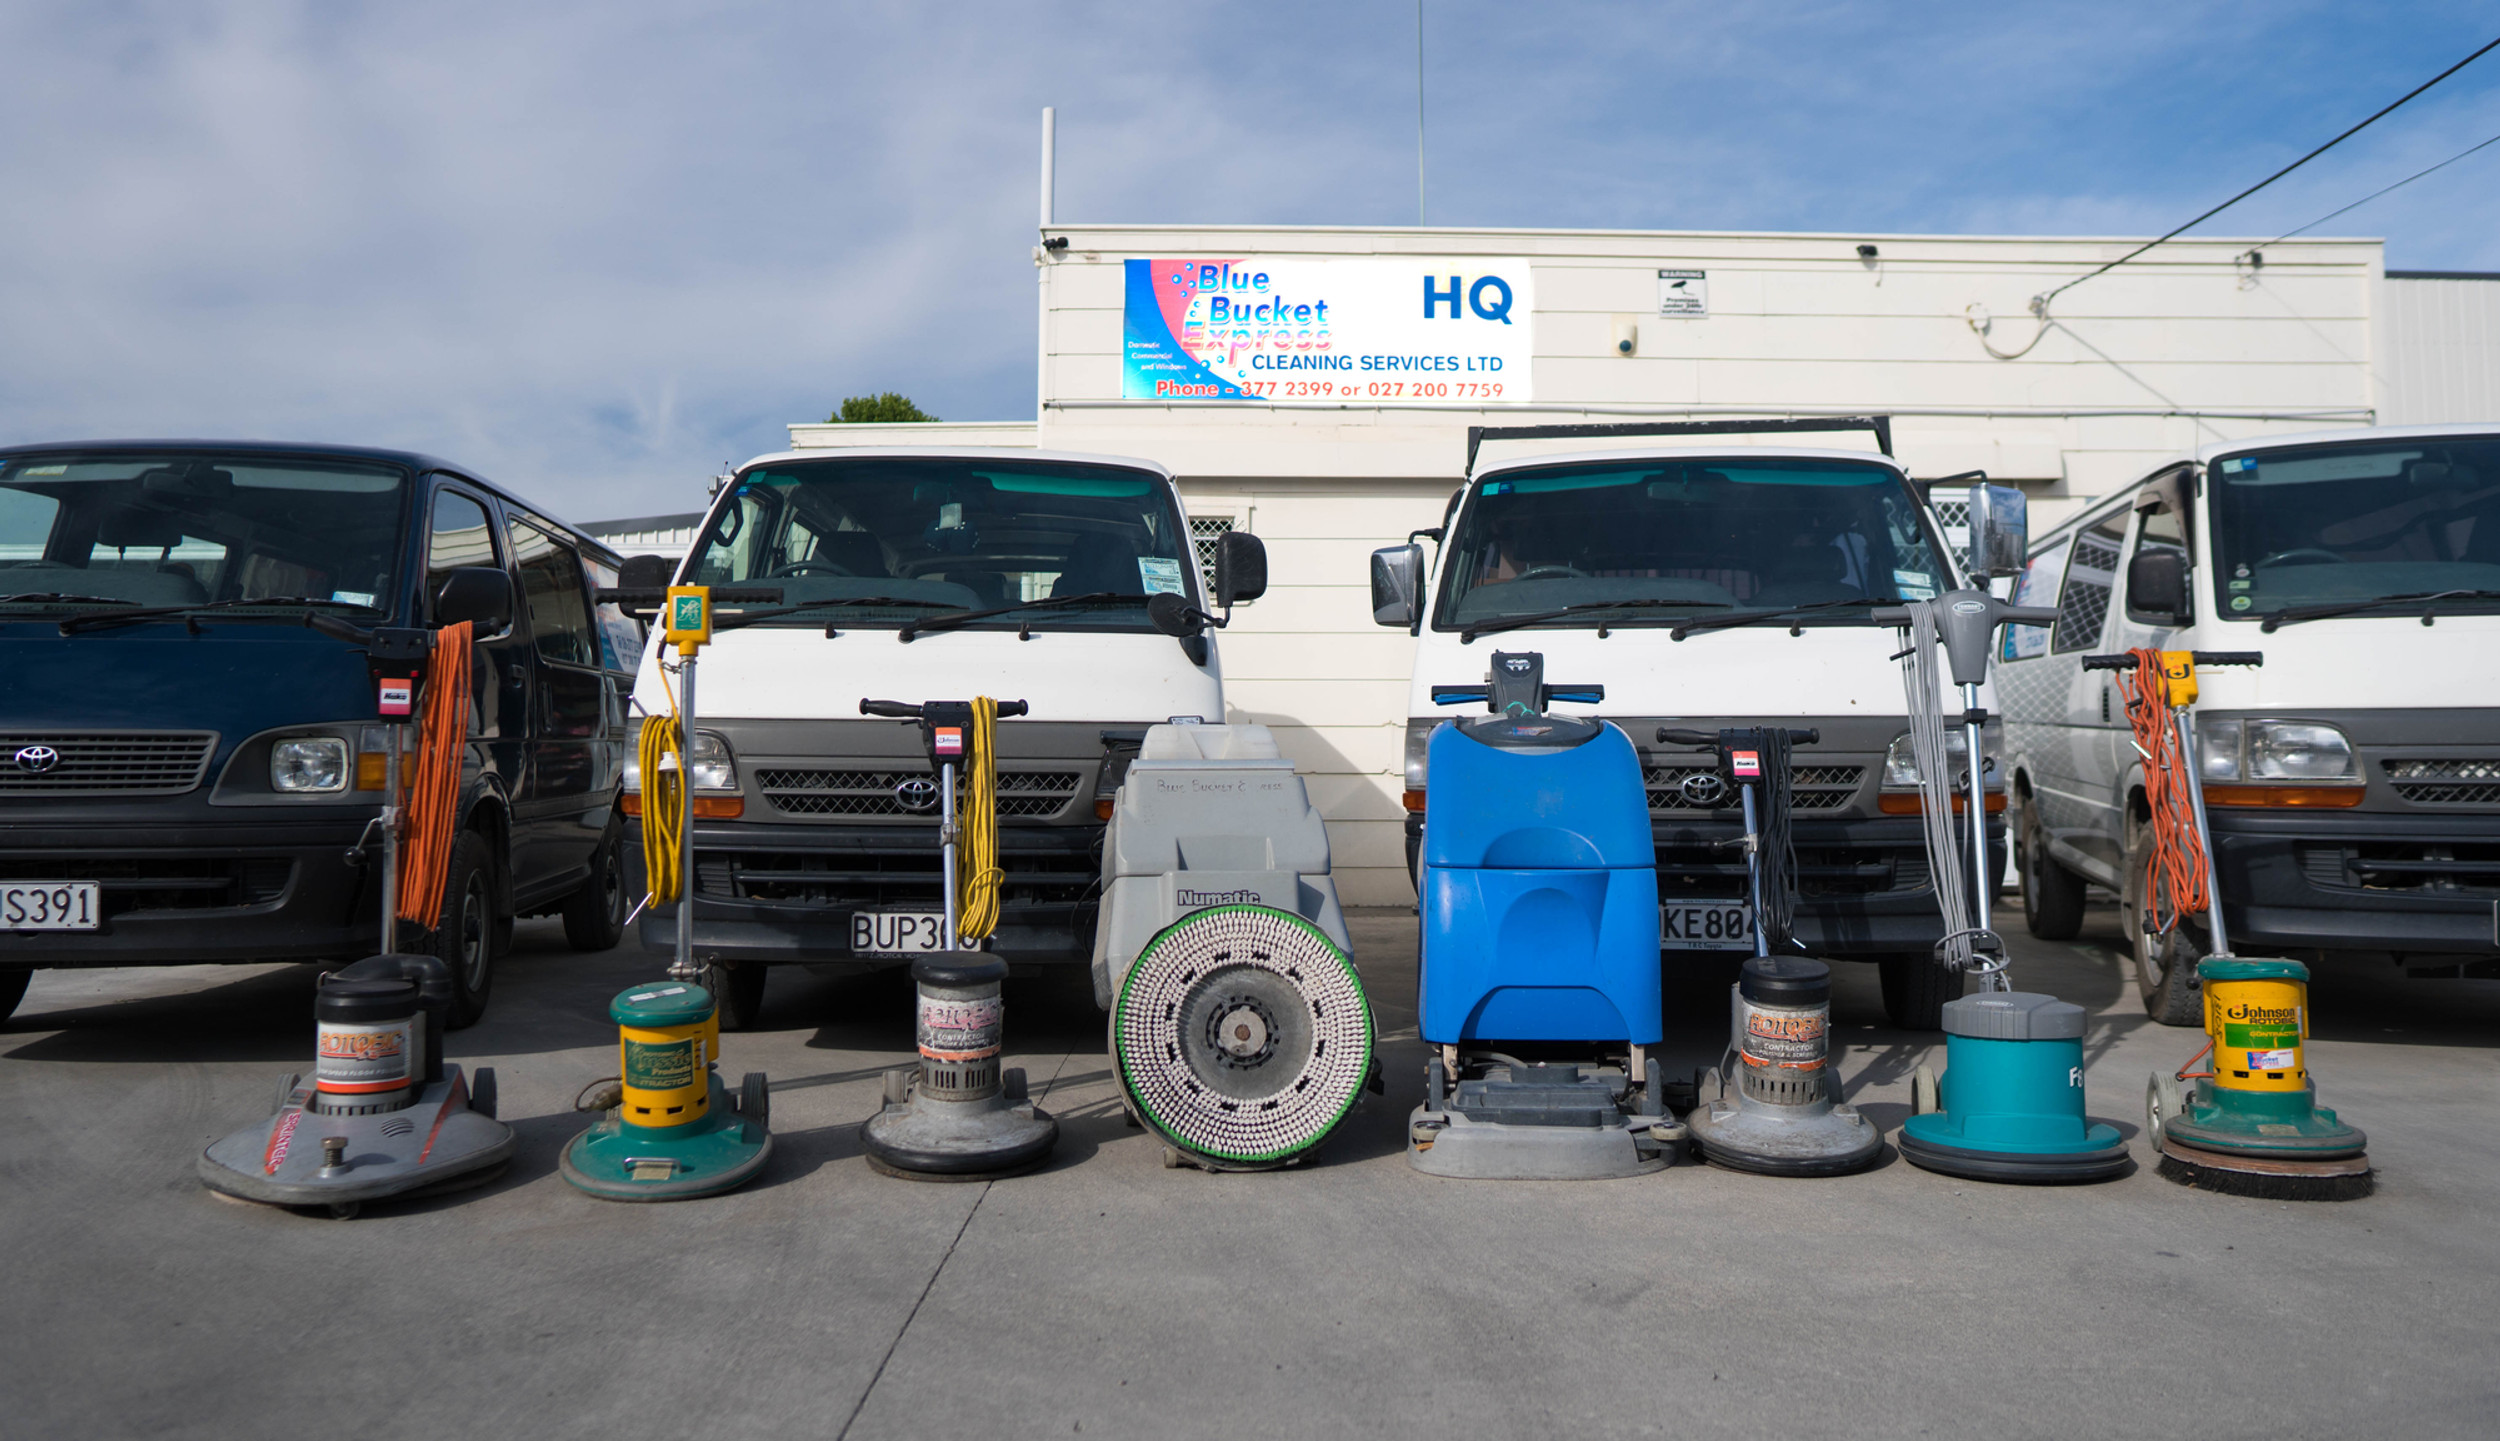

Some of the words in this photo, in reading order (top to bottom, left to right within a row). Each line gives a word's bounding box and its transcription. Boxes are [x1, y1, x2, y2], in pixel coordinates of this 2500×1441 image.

[1198, 263, 1271, 293] Blue
[1209, 295, 1330, 326] Bucket
[1423, 275, 1513, 324] HQ
[1181, 321, 1333, 368] Express
[1252, 354, 1353, 370] CLEANING
[1360, 355, 1460, 372] SERVICES
[1467, 357, 1503, 371] LTD
[1156, 379, 1218, 396] Phone
[1241, 382, 1278, 396] 377
[1285, 382, 1333, 396] 2399
[1341, 385, 1361, 396] or
[1368, 382, 1404, 397] 027
[1412, 383, 1448, 397] 200
[1456, 383, 1504, 397] 7759
[0, 888, 91, 924] S391
[1178, 889, 1261, 906] Numatic
[852, 915, 979, 950] BUP3
[1659, 908, 1754, 940] KE80
[2227, 1004, 2295, 1019] Johnson
